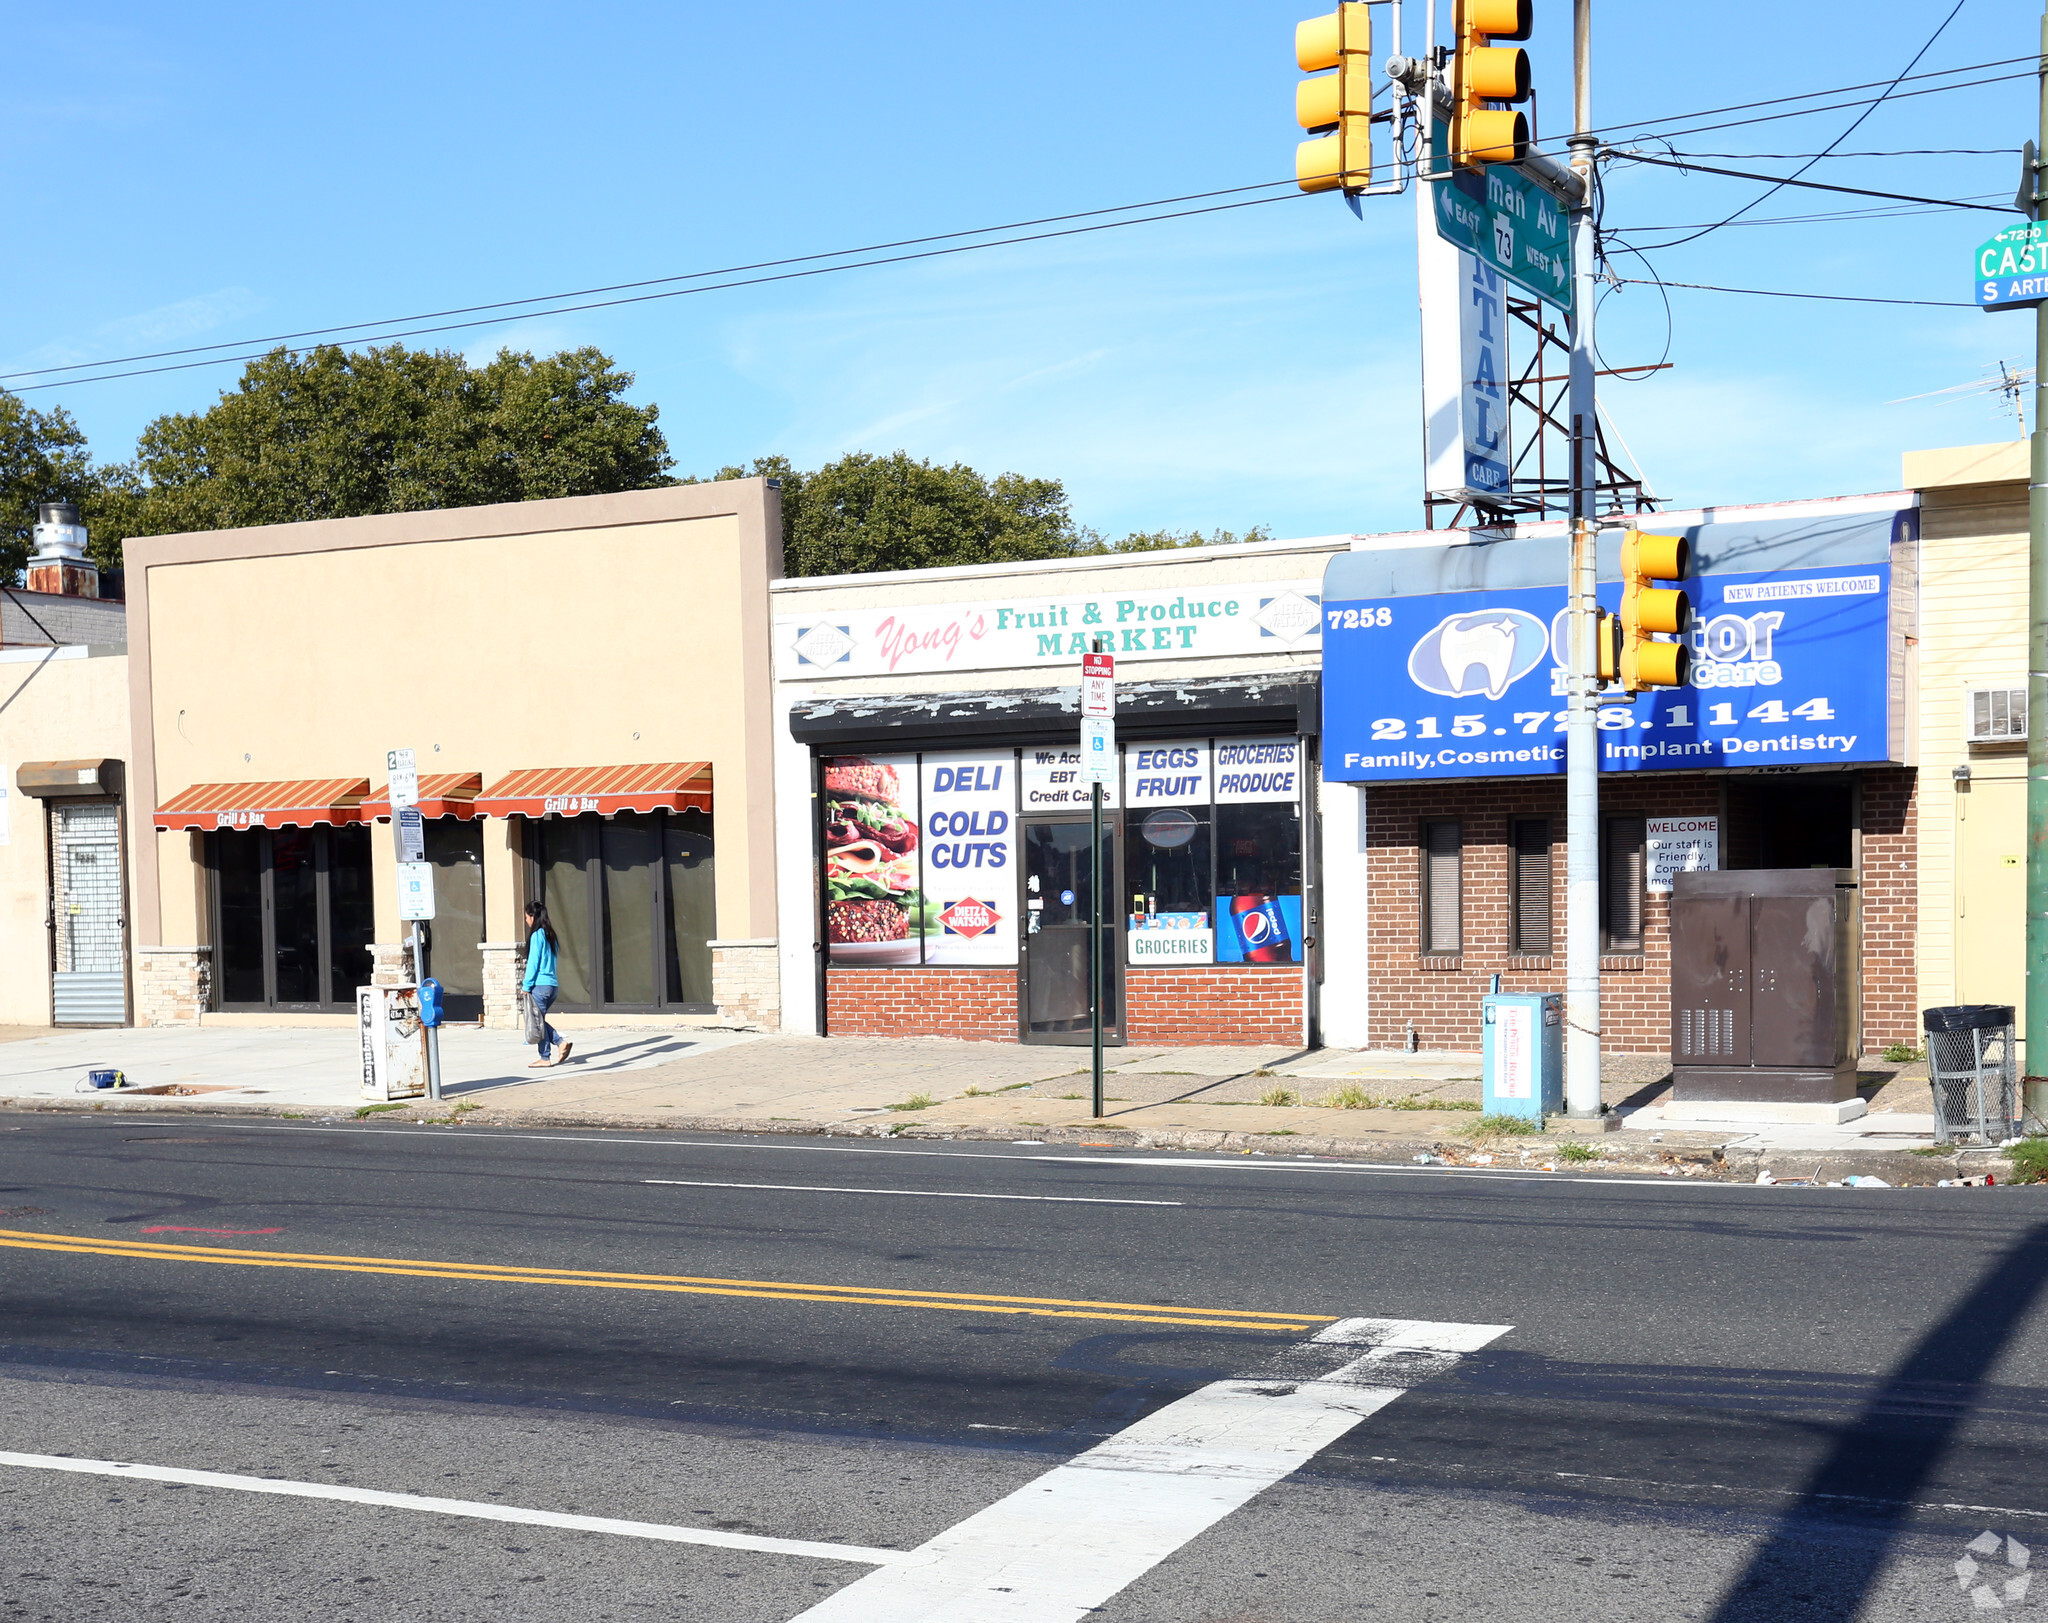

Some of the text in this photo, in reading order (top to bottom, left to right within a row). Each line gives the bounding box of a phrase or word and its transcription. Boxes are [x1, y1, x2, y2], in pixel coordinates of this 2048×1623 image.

[1488, 171, 1558, 240] man Av
[1455, 202, 1481, 236] EAST
[1495, 227, 1512, 257] 73
[2008, 227, 2042, 242] 7200
[1526, 244, 1550, 274] WEST
[1983, 281, 1999, 302] S
[1472, 254, 1500, 452] NTAL
[1472, 460, 1501, 488] CARE
[1728, 578, 1877, 601] NEW PATIENTS WELCOME
[997, 596, 1240, 630] Fruit & Produce
[1327, 606, 1393, 630] 7258
[875, 610, 990, 672] Yong's
[1036, 625, 1197, 657] MARKET
[1085, 665, 1112, 677] STOPPING
[1093, 656, 1103, 665] NO
[1091, 680, 1105, 690] ANY
[1090, 691, 1106, 702] TIME
[388, 752, 396, 769] 2
[1035, 752, 1056, 764] We
[1058, 751, 1081, 764] Acc
[1136, 748, 1200, 770] EGGS
[1218, 743, 1295, 766] GROCERIES
[1344, 732, 1858, 770] Family,Cosmetic Implant Dentistry
[933, 765, 1003, 793] DELI
[1049, 771, 1078, 783] EBT
[1135, 776, 1202, 797] FRUIT
[1218, 772, 1295, 794] PRODUCE
[544, 797, 600, 811] Grill & Bar
[1029, 789, 1111, 802] Credit Cars
[216, 811, 266, 826] Grill & Bar
[928, 810, 1009, 838] COLD
[1647, 821, 1717, 833] WELCOME
[1146, 820, 1192, 839] OPEN
[1652, 839, 1713, 850] Our staff is
[931, 842, 1008, 869] CUTS
[1658, 851, 1706, 862] Friendly.
[1654, 863, 1711, 874] Come and
[1651, 878, 1674, 886] mee
[947, 916, 990, 928] WATSON
[954, 906, 989, 917] DIETZ &
[1265, 908, 1282, 936] pepsi
[1135, 938, 1208, 955] GROCERIES
